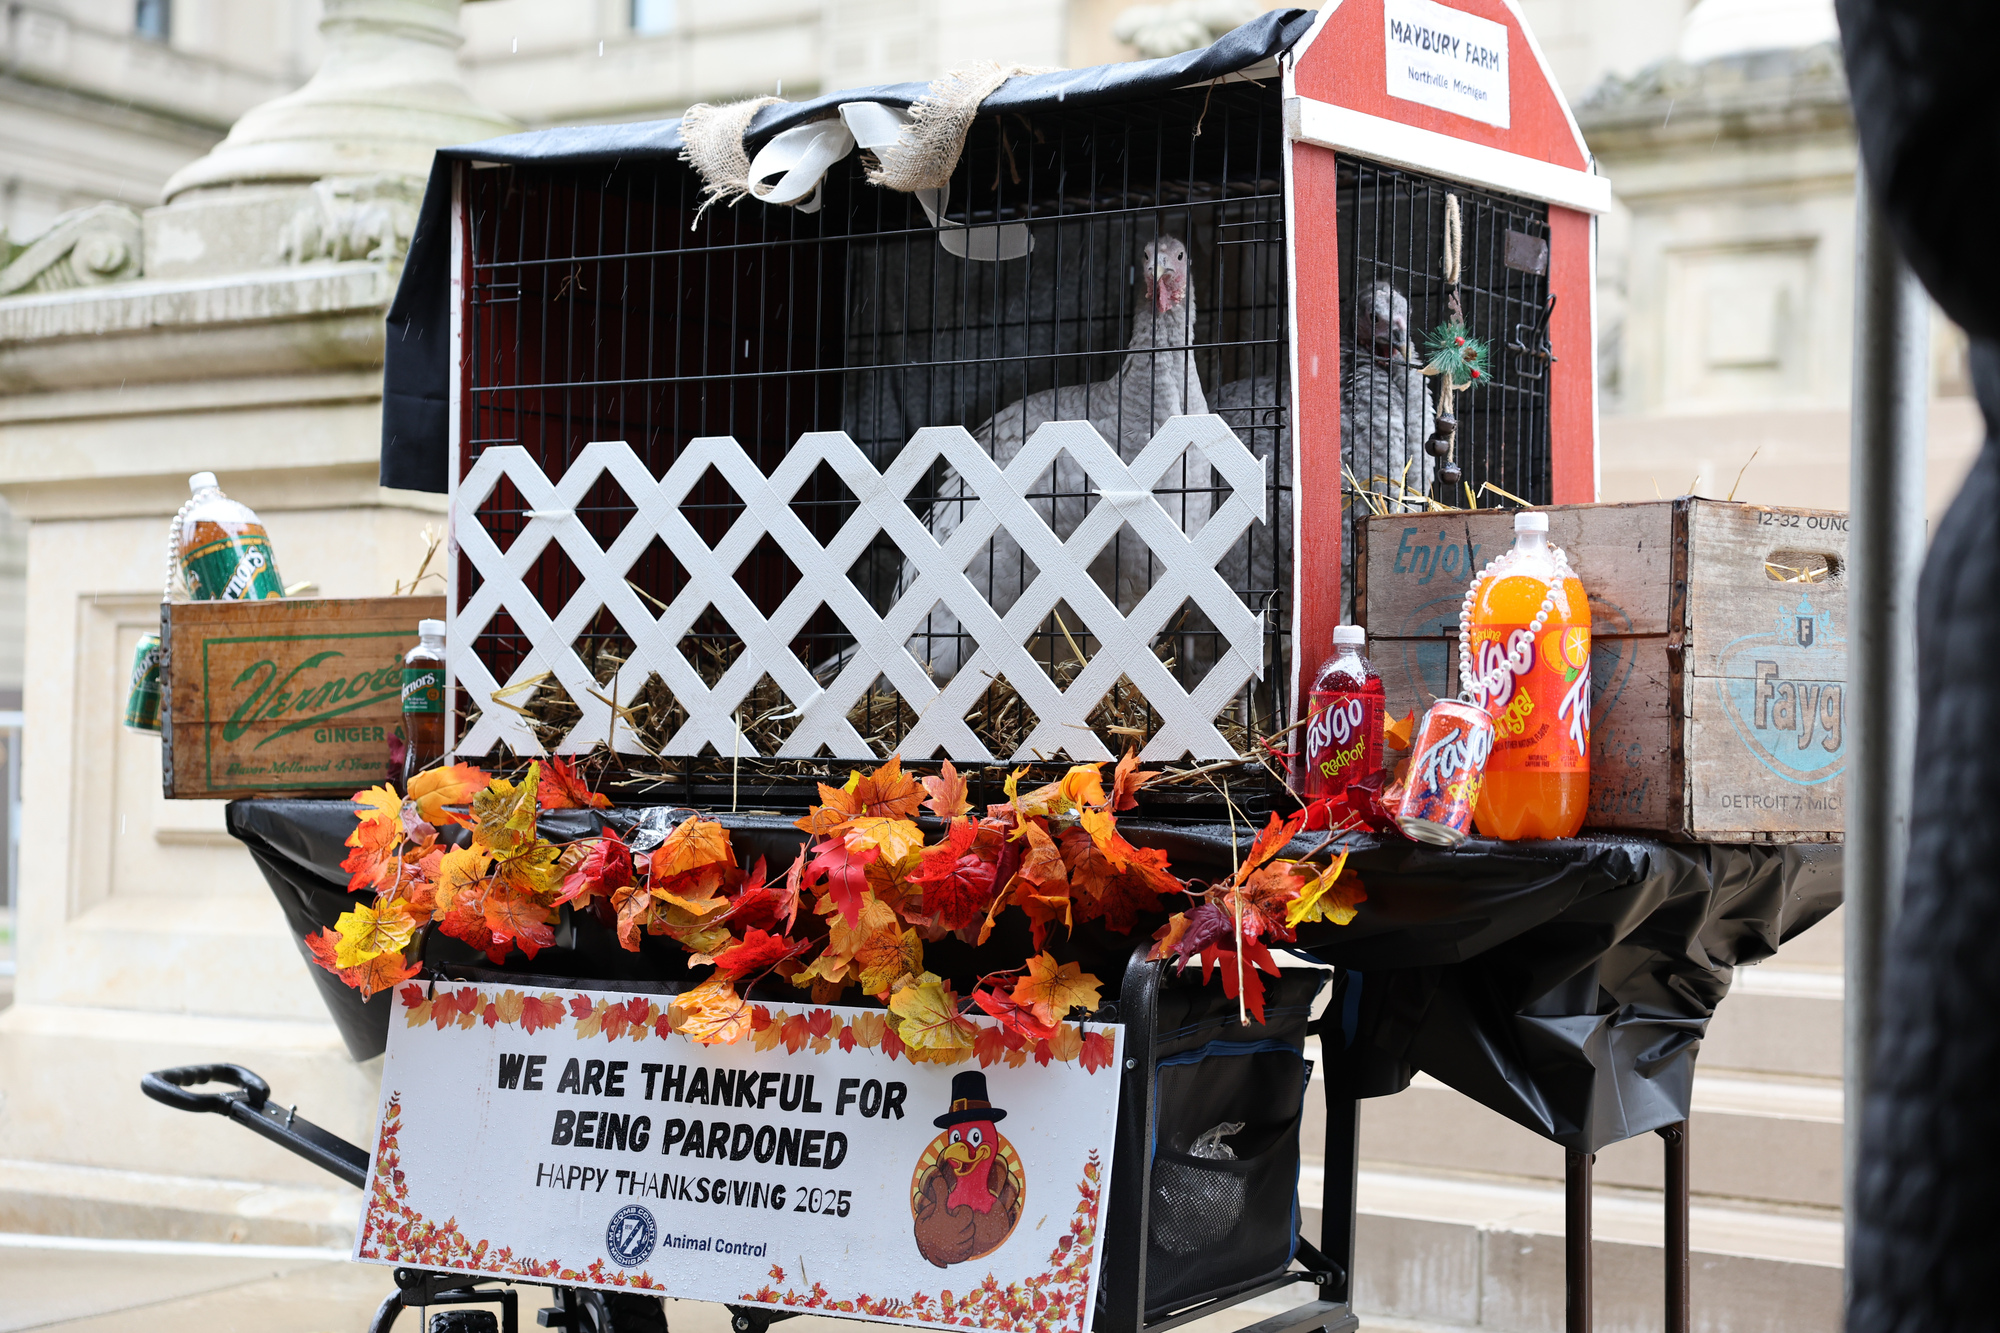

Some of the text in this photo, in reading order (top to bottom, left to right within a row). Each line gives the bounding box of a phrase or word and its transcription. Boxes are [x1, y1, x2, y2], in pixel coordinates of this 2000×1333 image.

[1391, 18, 1500, 72] MAYBURY FARM
[1408, 65, 1487, 101] Northville Michigan
[1758, 511, 1800, 528] 12-32
[1392, 527, 1482, 585] Enjoy
[1471, 629, 1536, 710] ygo
[1491, 687, 1535, 742] ange!
[1754, 660, 1846, 753] Fayg
[314, 726, 385, 743] GINGER
[1307, 699, 1363, 773] Faygo
[1320, 734, 1366, 778] Redpop!
[268, 759, 332, 774] Mellowed
[333, 759, 346, 771] 4
[349, 757, 382, 772] Years
[1721, 795, 1788, 810] DETROIT
[1808, 797, 1842, 810] MIC
[498, 1053, 908, 1120] WE ARE THANKFUL FOR
[551, 1110, 848, 1169] BEING PARDONED
[536, 1163, 852, 1218] HAPPY THANKSGIVING 2025
[609, 1207, 655, 1245] MACOMB COUNTY
[663, 1233, 767, 1257] Animal Control
[610, 1247, 649, 1266] MICHIGAN
